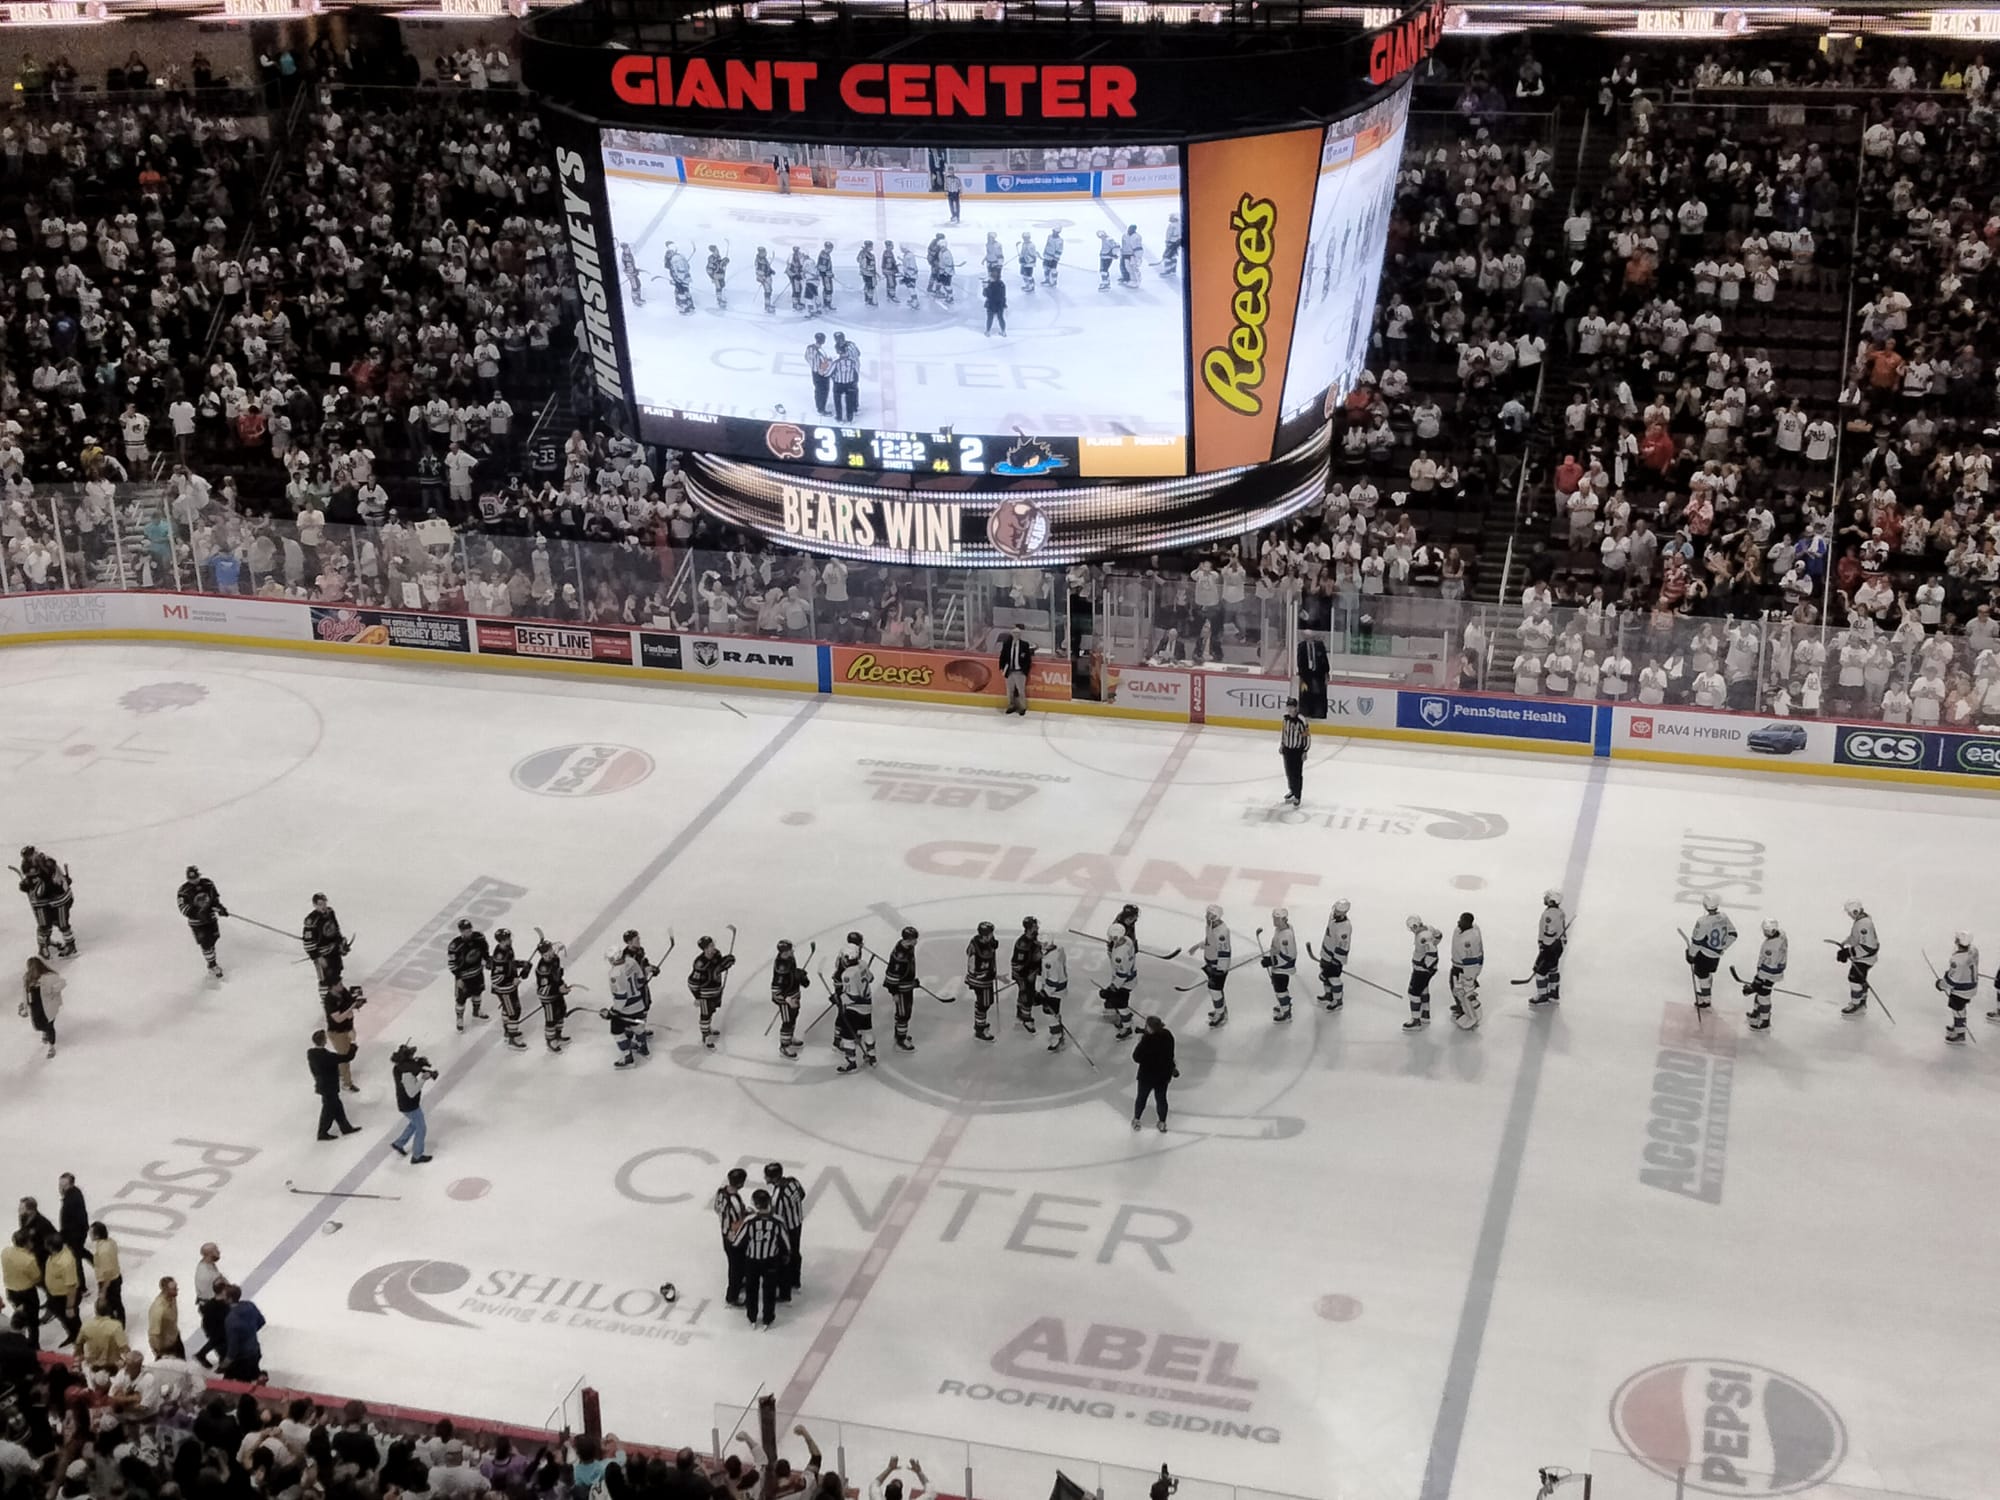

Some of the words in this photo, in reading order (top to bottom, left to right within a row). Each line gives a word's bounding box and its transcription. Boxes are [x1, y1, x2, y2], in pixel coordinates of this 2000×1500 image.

[948, 3, 976, 21] WIN!
[1164, 7, 1190, 23] WIN!
[1638, 11, 1681, 31] BEARS
[1683, 11, 1714, 31] WIN!
[1932, 14, 1976, 32] BEARS
[1370, 11, 1427, 85] GIANT
[611, 55, 818, 112] GIANT
[840, 63, 1137, 118] CENTER
[625, 156, 664, 169] RAM
[556, 146, 624, 400] HERSHEY'S
[1201, 192, 1277, 416] Reese's
[643, 405, 674, 418] PLAYER
[682, 411, 719, 424] PENALTY
[813, 427, 837, 461] 3
[875, 430, 907, 441] PERIOD
[909, 433, 917, 442] 4
[540, 450, 556, 463] 33
[870, 439, 926, 461] 12:22
[960, 437, 984, 471] 2
[882, 460, 914, 471] SHOTS
[783, 486, 876, 548] BEARS
[885, 500, 961, 553] WIN!
[24, 596, 105, 610] HARRISBURG
[163, 604, 189, 620] MI
[25, 610, 105, 625] UNIVERSITY
[390, 626, 430, 639] HERSHEY
[431, 629, 461, 642] BEARS
[517, 628, 554, 646] BEST
[558, 632, 590, 649] LINE
[723, 651, 793, 668] RAM
[847, 653, 933, 685] Reese's
[1127, 680, 1181, 696] GIANT
[1240, 692, 1349, 715] HIGHRK
[1454, 704, 1520, 720] PennState
[1522, 709, 1567, 724] Health
[1657, 724, 1690, 737] RAV4
[1693, 726, 1741, 740] HYBRID
[1850, 735, 1918, 761] ecs
[904, 839, 1324, 909] GIANT
[1639, 1049, 1708, 1196] ACCORD
[476, 1269, 712, 1326] SHILOH
[459, 1297, 532, 1323] Paving
[541, 1309, 560, 1323] &
[567, 1313, 693, 1346] Excavating
[991, 1316, 1259, 1391] ABEL
[937, 1379, 1115, 1420] ROOFING
[1145, 1410, 1281, 1444] SIDING
[1701, 1367, 1753, 1487] PEPSI
